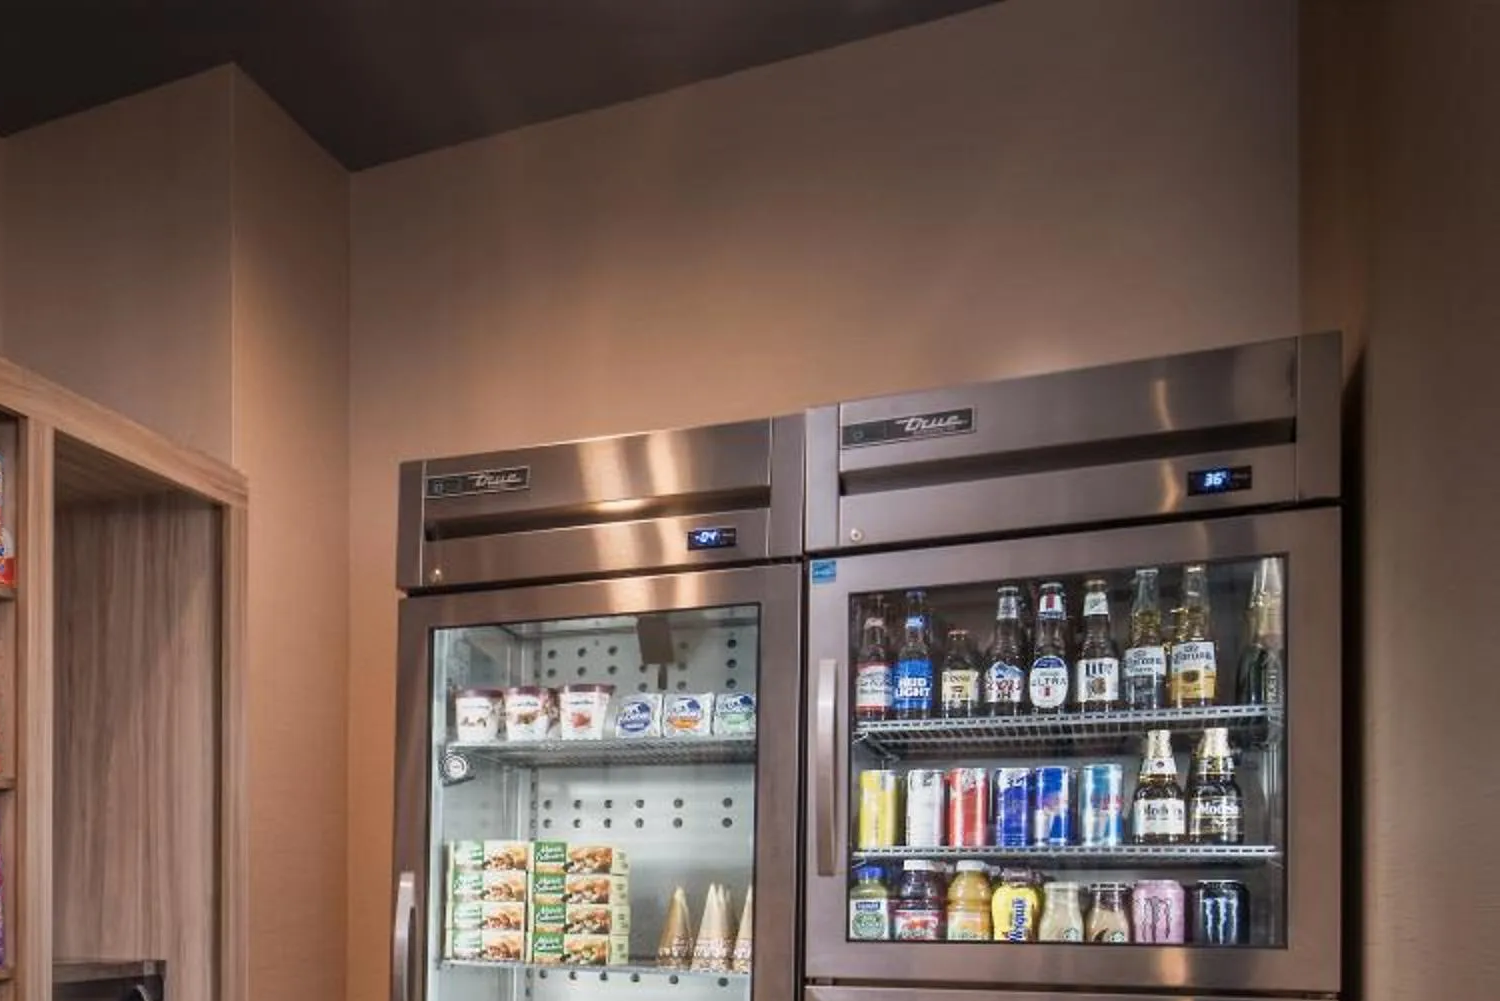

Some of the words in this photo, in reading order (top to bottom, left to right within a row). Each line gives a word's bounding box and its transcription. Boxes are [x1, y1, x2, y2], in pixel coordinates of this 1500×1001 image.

[897, 415, 965, 431] True
[897, 677, 927, 688] BUD
[1031, 677, 1068, 688] ULTRA
[895, 686, 931, 698] LIGHT
